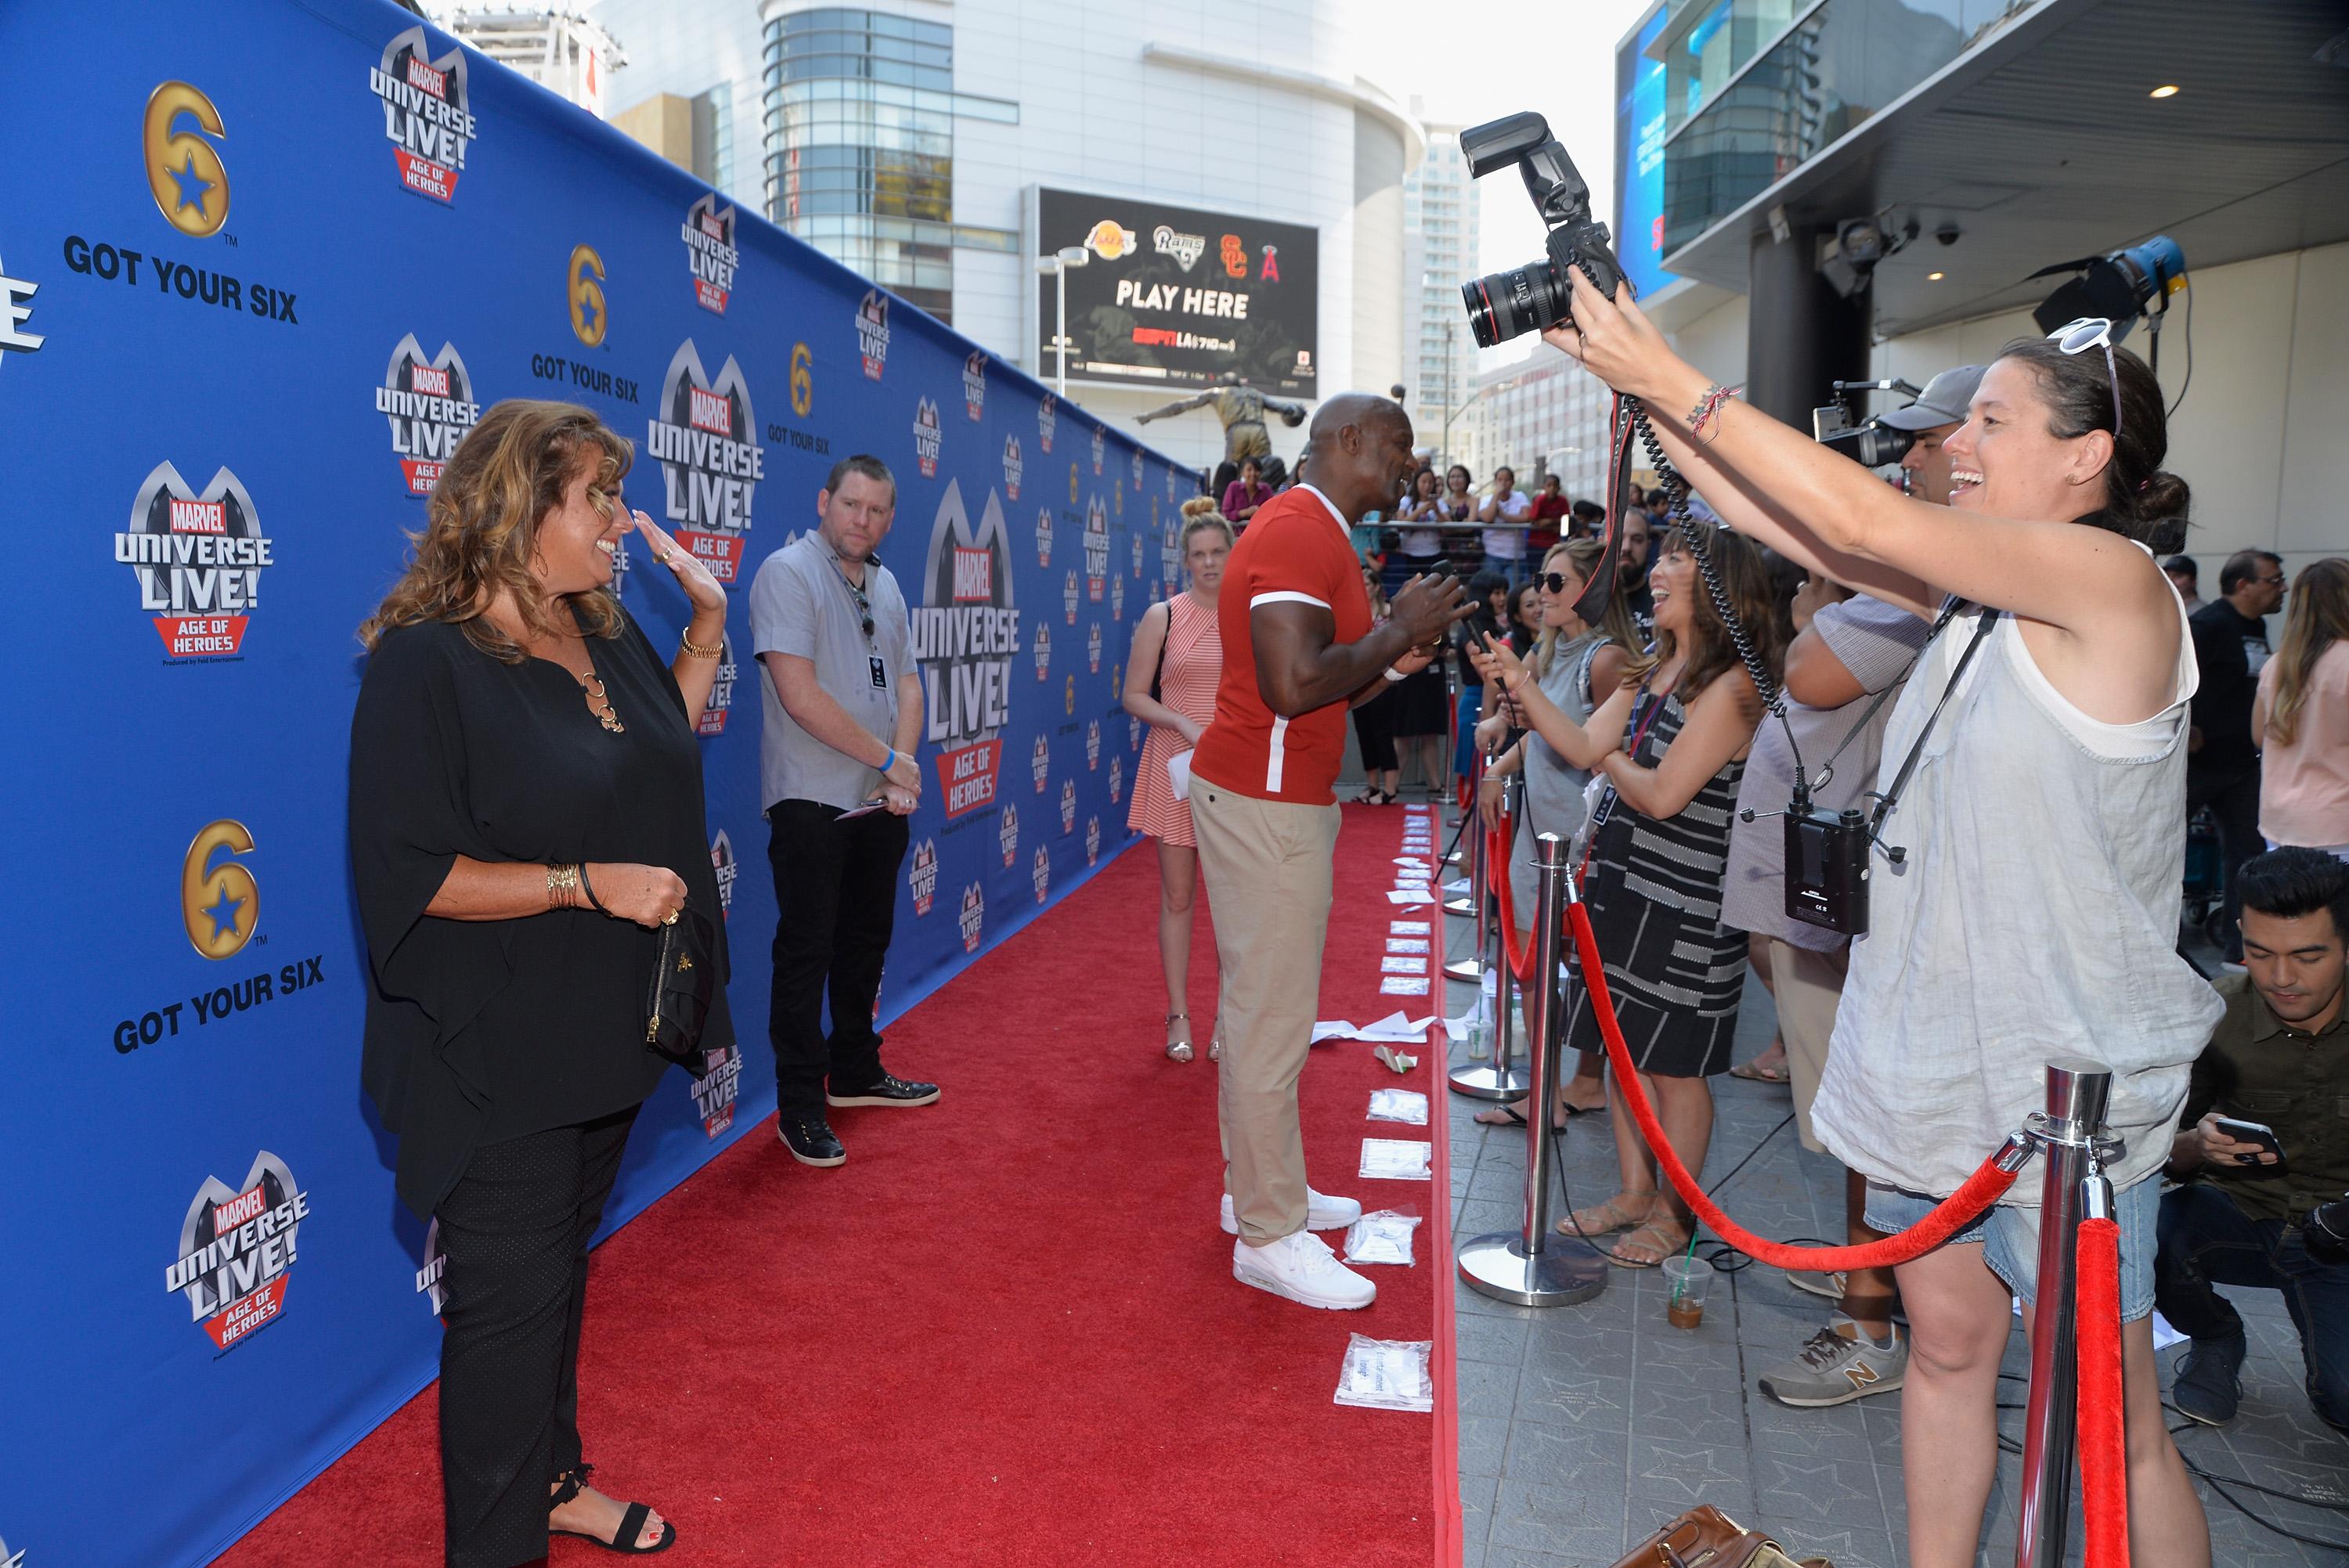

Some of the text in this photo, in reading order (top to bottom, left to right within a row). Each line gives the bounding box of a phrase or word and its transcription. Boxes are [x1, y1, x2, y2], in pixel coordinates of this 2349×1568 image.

[410, 59, 444, 97] MARVEL
[370, 67, 476, 139] UNIVERSE
[143, 80, 230, 236] 6
[386, 103, 465, 171] LIVE!
[406, 170, 447, 199] HEROES
[409, 158, 446, 181] AGE OF
[681, 222, 739, 269] UNIVERSE
[63, 235, 299, 325] GOT YOUR SIX
[689, 247, 733, 291] LIVE!
[568, 243, 607, 348] 6
[1117, 279, 1250, 320] PLAY HERE
[860, 330, 886, 362] LIVE!
[413, 367, 449, 395] MARVEL
[532, 354, 639, 404] GOT YOUR SIX
[790, 341, 812, 417] 6
[377, 387, 480, 425] UNIVERSE
[691, 391, 730, 433] MARVEL
[648, 419, 764, 480] UNIVERSE
[768, 424, 829, 456] GOT YOUR SIX
[416, 464, 437, 478] AGE
[171, 502, 225, 532] MARVEL
[666, 467, 752, 530] LIVE!
[115, 533, 274, 566] UNIVERSE
[692, 536, 730, 557] AGE OF
[141, 568, 258, 611] LIVE!
[955, 550, 990, 598] MARVEL
[174, 636, 234, 653] HEROES
[178, 620, 229, 636] AGE OF
[911, 606, 1020, 660] UNIVERSE
[163, 658, 189, 667] Produced
[928, 661, 1009, 742] LIVE!
[953, 746, 990, 781] AGE OF
[949, 773, 993, 814] HEROES
[181, 819, 259, 961] 6
[913, 874, 935, 901] LIVE!
[254, 935, 268, 947] TM
[962, 914, 982, 940] LIVE!
[114, 954, 324, 1054] GOT YOUR SIX
[691, 1054, 743, 1100] UNIVERSE
[700, 1074, 738, 1120] LIVE!
[216, 1188, 264, 1235] MARVEL
[166, 1191, 310, 1293] UNIVERSE
[191, 1227, 297, 1323] LIVE!
[222, 1299, 276, 1345] HEROES
[226, 1287, 272, 1327] AGE OF
[1843, 1360, 1880, 1390] N
